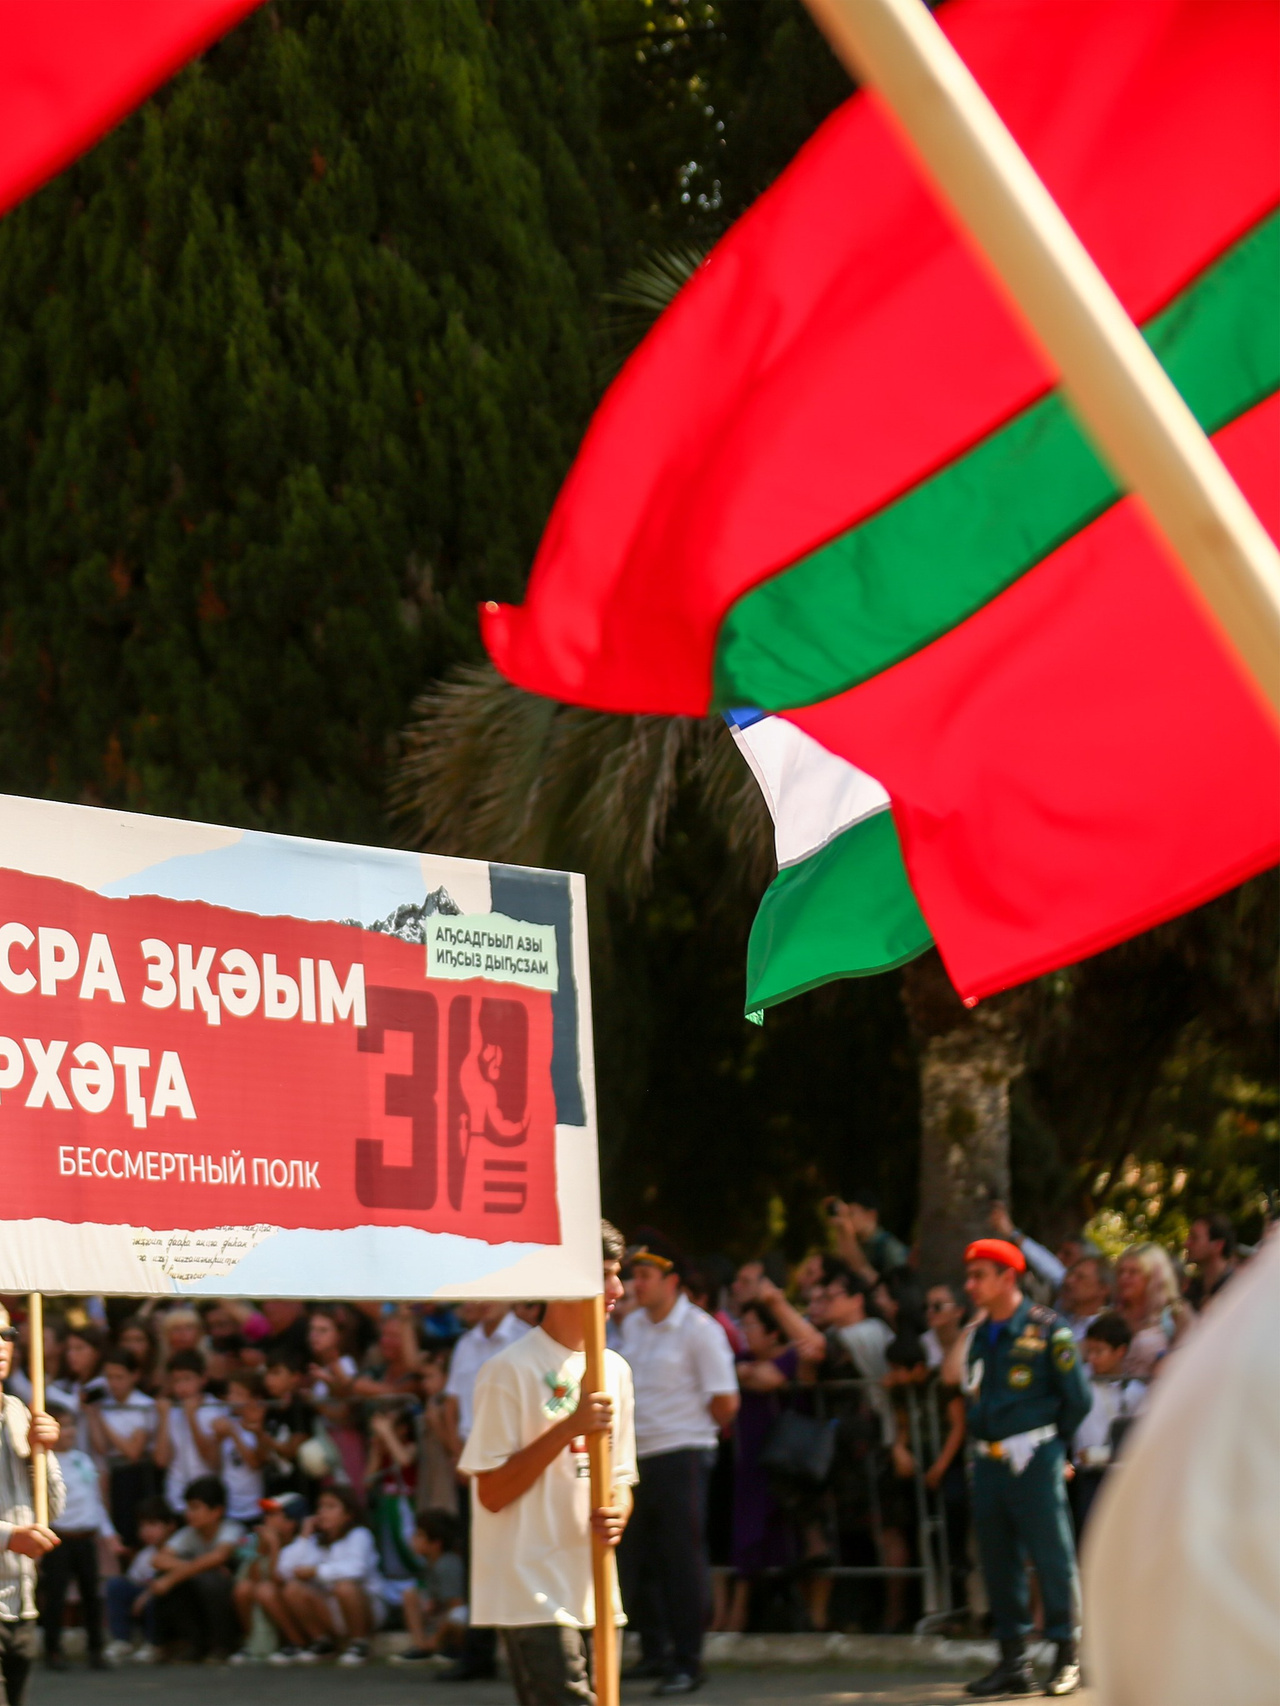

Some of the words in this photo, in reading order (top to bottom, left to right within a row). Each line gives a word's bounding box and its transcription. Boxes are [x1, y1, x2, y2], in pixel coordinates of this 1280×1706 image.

[517, 936, 543, 953] АЗЫ
[59, 1145, 247, 1186] БЕССМЕРТНЫЙ
[252, 1157, 321, 1189] ПОЛК
